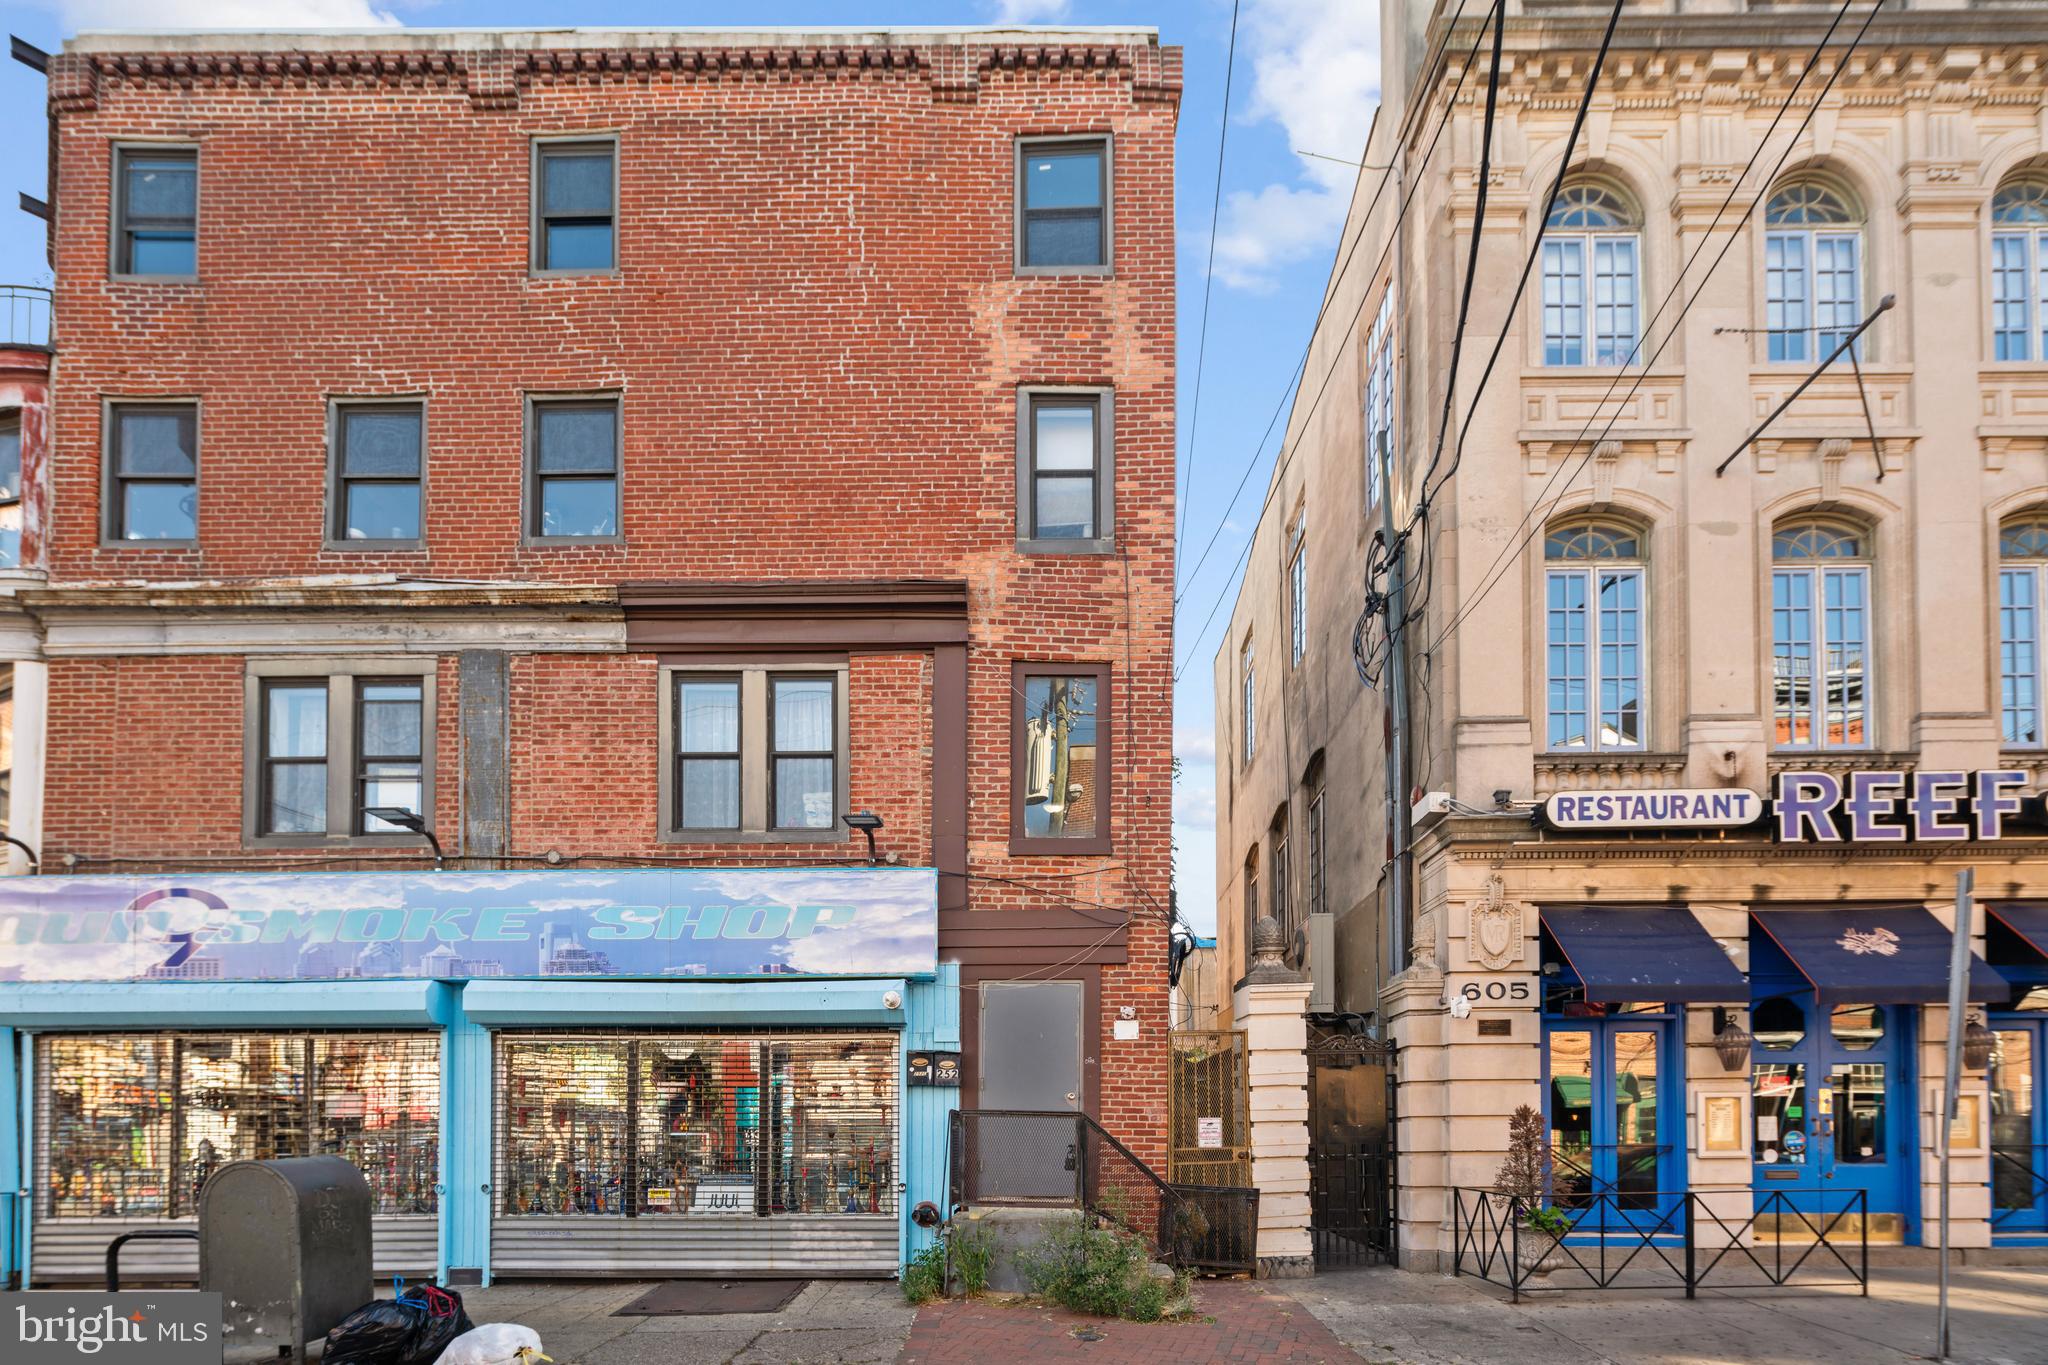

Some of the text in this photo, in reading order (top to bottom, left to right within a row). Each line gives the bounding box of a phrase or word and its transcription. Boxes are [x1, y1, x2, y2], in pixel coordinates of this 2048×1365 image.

[1556, 794, 1750, 822] RESTAURANT
[1773, 770, 2029, 842] REEF
[193, 906, 539, 944] SMOKE
[587, 904, 857, 941] SHOP
[1461, 982, 1529, 1000] 605
[936, 1069, 959, 1079] 252
